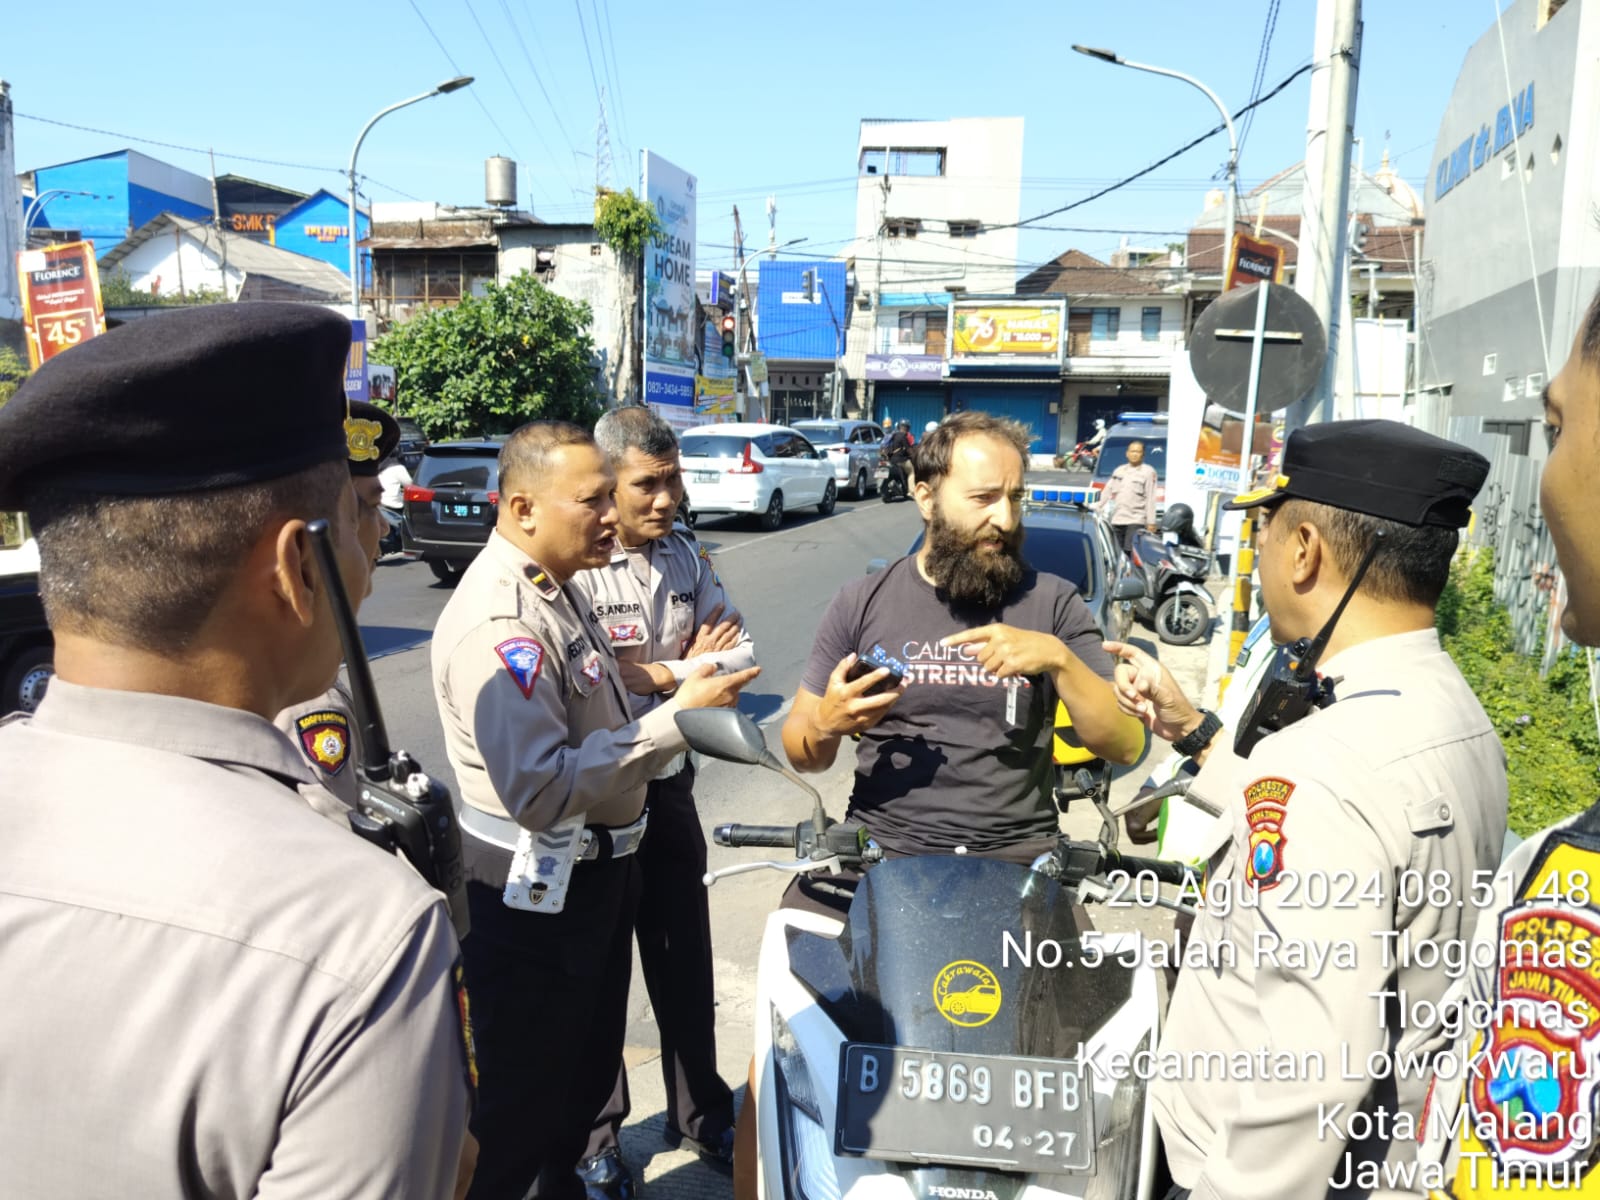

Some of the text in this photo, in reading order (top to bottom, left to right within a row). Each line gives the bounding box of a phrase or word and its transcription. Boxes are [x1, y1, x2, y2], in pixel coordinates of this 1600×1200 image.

[1493, 79, 1535, 158] IRMA
[232, 213, 264, 231] SMK
[654, 232, 691, 261] DREAM
[34, 265, 81, 282] FLORENCE
[654, 252, 691, 288] HOME
[1238, 256, 1273, 276] FLORENCE
[47, 318, 82, 346] 45
[1207, 467, 1241, 482] DOCTO
[671, 592, 696, 606] POL
[902, 640, 976, 661] CALIFO
[901, 663, 1031, 688] STRENG
[937, 965, 992, 996] Cakrawala
[1508, 970, 1550, 994] JAWA
[859, 1053, 1081, 1112] B 5869 BFB
[927, 1184, 1000, 1200] HONDA
